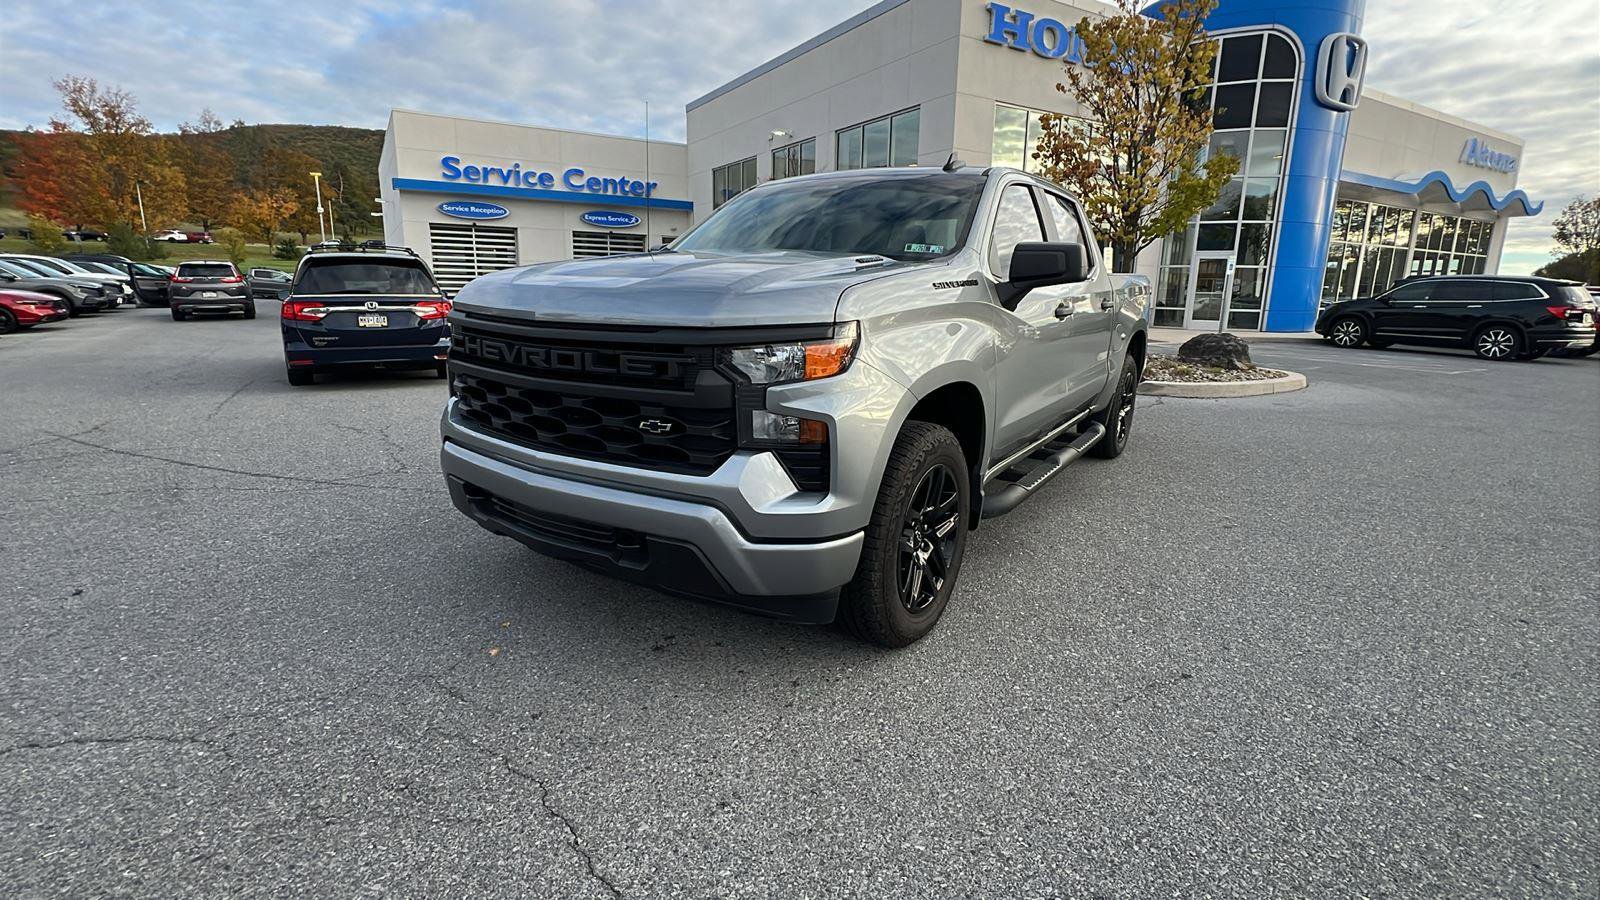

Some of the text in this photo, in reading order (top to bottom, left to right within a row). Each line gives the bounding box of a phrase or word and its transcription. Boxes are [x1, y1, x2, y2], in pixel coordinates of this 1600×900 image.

[441, 155, 658, 197] Service Center
[443, 204, 505, 215] Service Reception
[584, 214, 629, 223] Express Service
[451, 334, 698, 378] CHEVROLET
